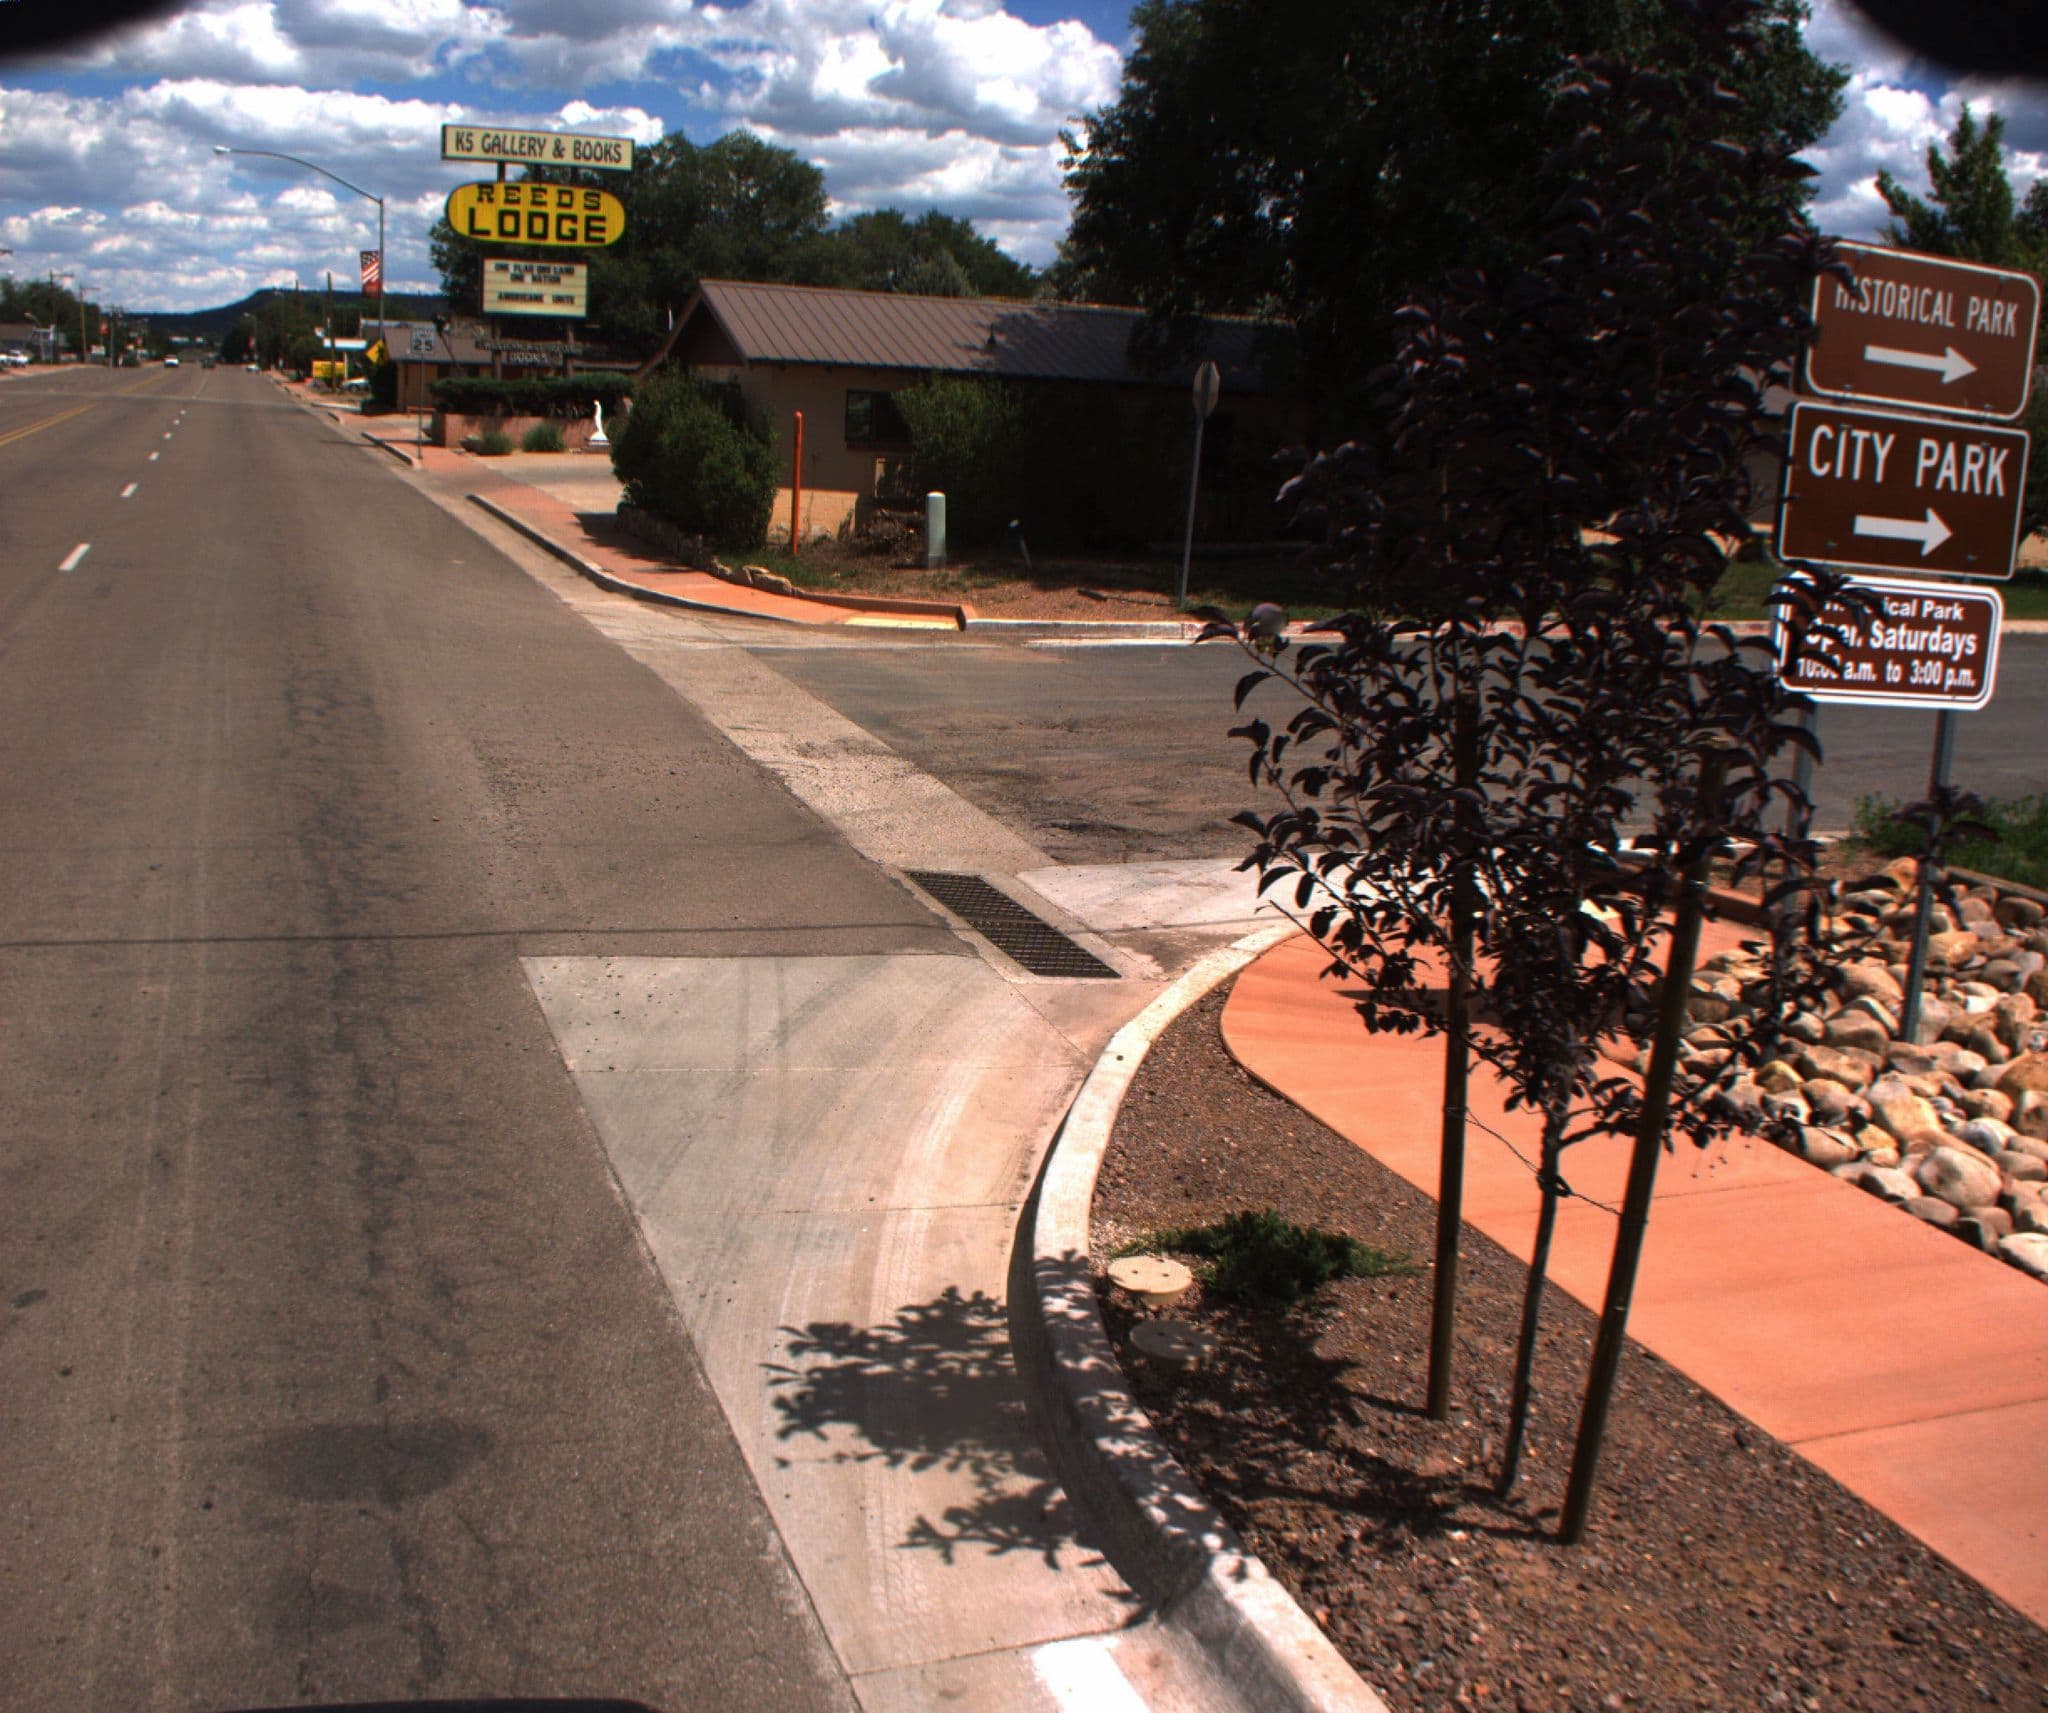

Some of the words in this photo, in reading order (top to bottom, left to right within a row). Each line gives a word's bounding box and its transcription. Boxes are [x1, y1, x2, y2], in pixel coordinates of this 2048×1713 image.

[481, 132, 547, 159] GALLERY
[552, 138, 566, 159] &
[573, 139, 622, 163] BOOKS
[476, 183, 602, 210] REEDS
[468, 206, 608, 244] LODGE
[1966, 295, 2019, 338] PARK
[413, 338, 433, 352] 25
[1808, 424, 1895, 484] CITY
[1915, 437, 2010, 498] PARK
[1921, 599, 1965, 622] Park
[1869, 618, 1978, 662] Saturdays
[1843, 660, 1878, 683] a.m.
[1885, 659, 1902, 684] to
[1909, 659, 1942, 686] 3:00
[1944, 667, 1977, 692] p.m.
